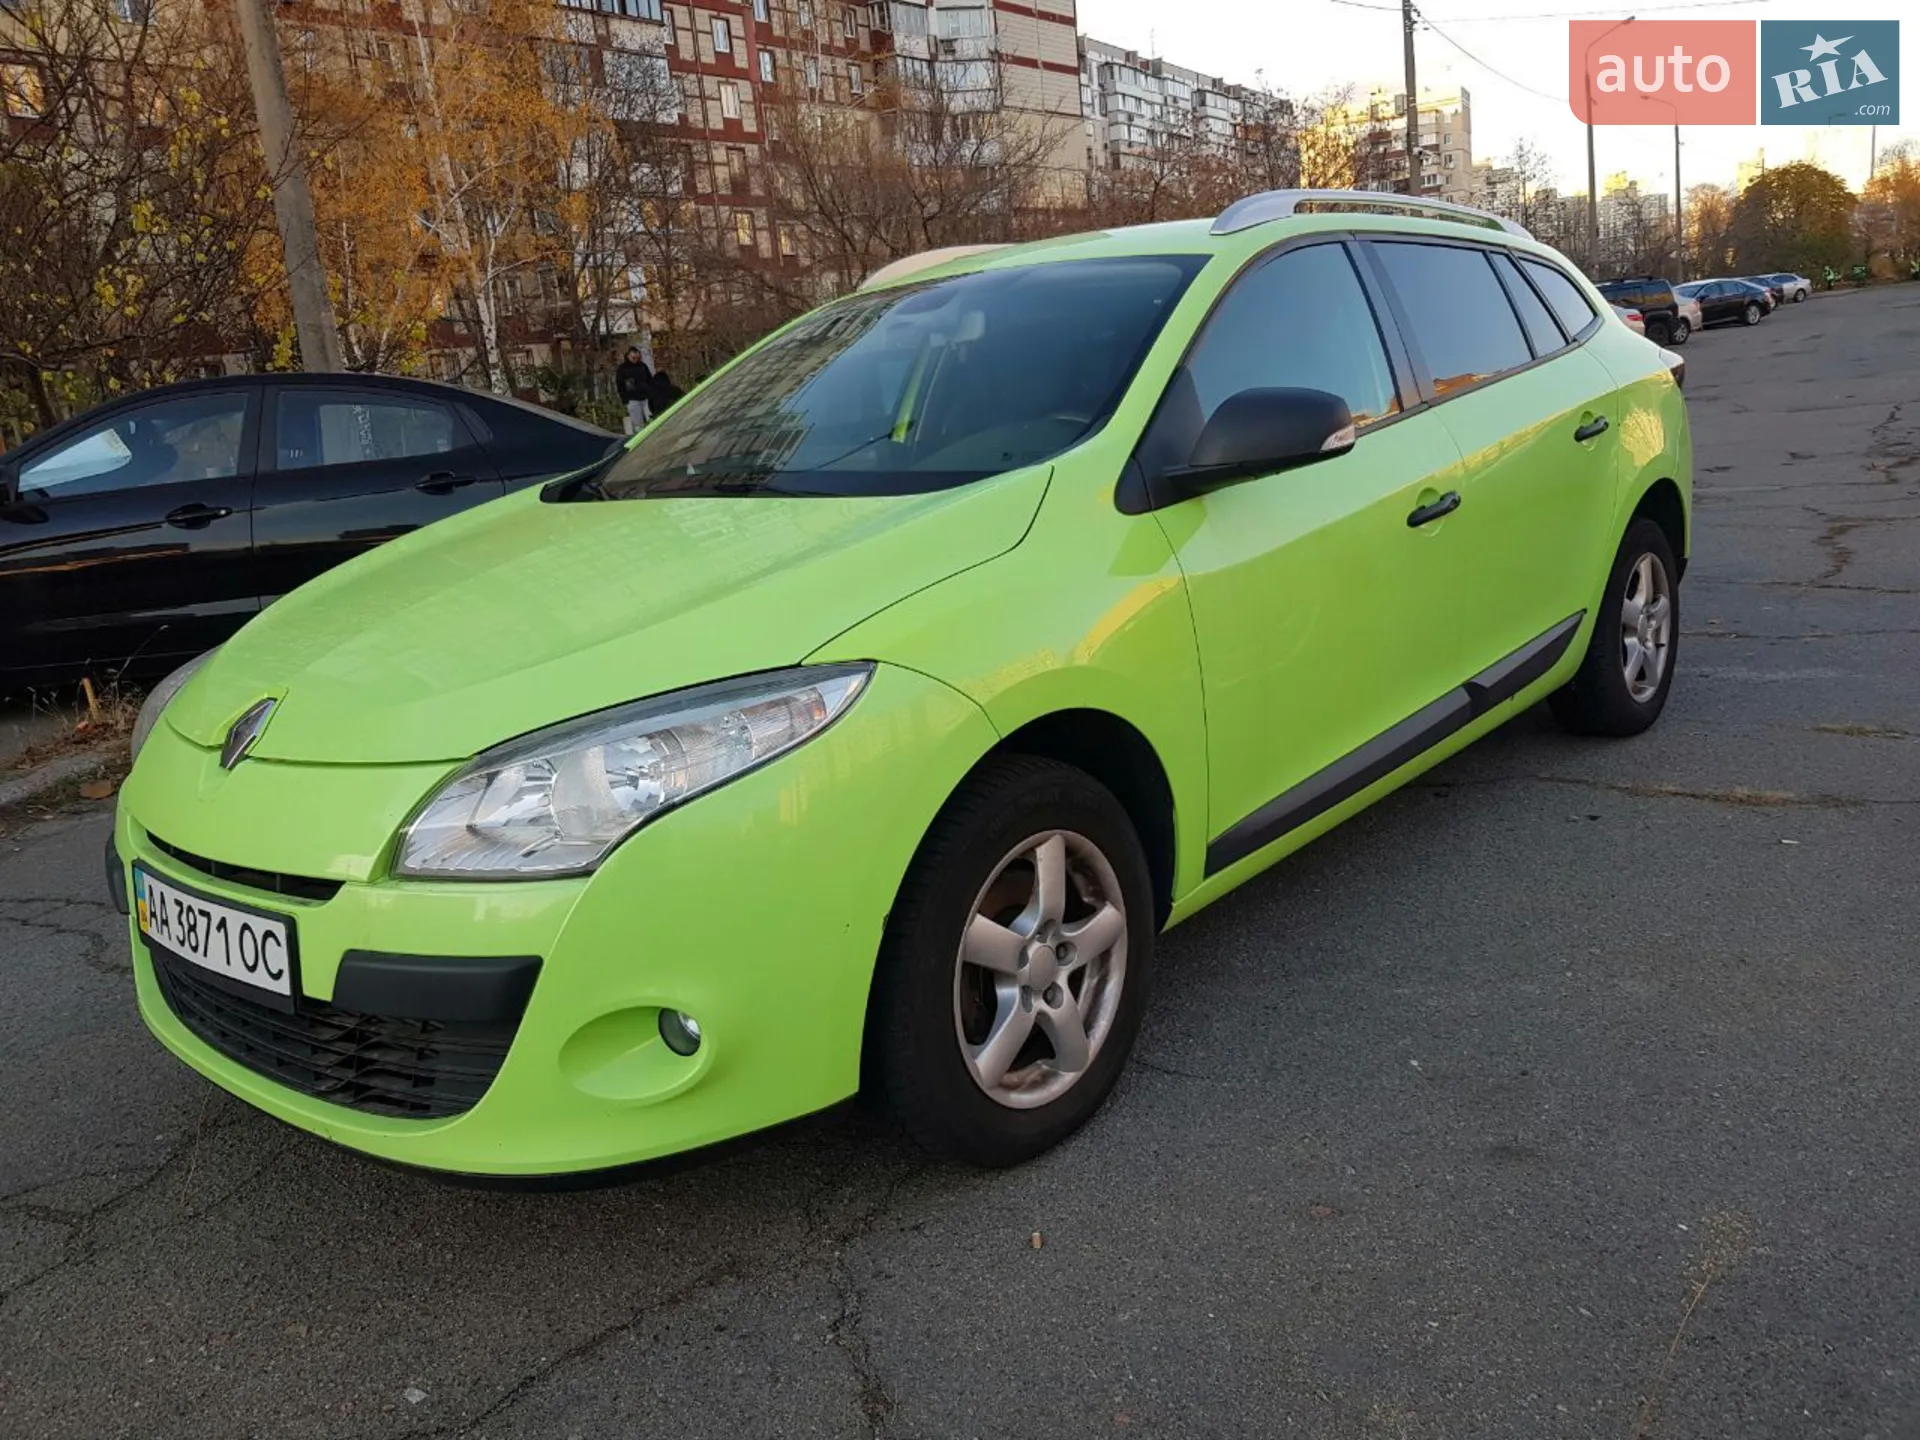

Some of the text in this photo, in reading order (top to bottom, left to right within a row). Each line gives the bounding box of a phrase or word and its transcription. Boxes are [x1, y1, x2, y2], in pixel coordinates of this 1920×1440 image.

[148, 884, 285, 982] AA 3871 OC
